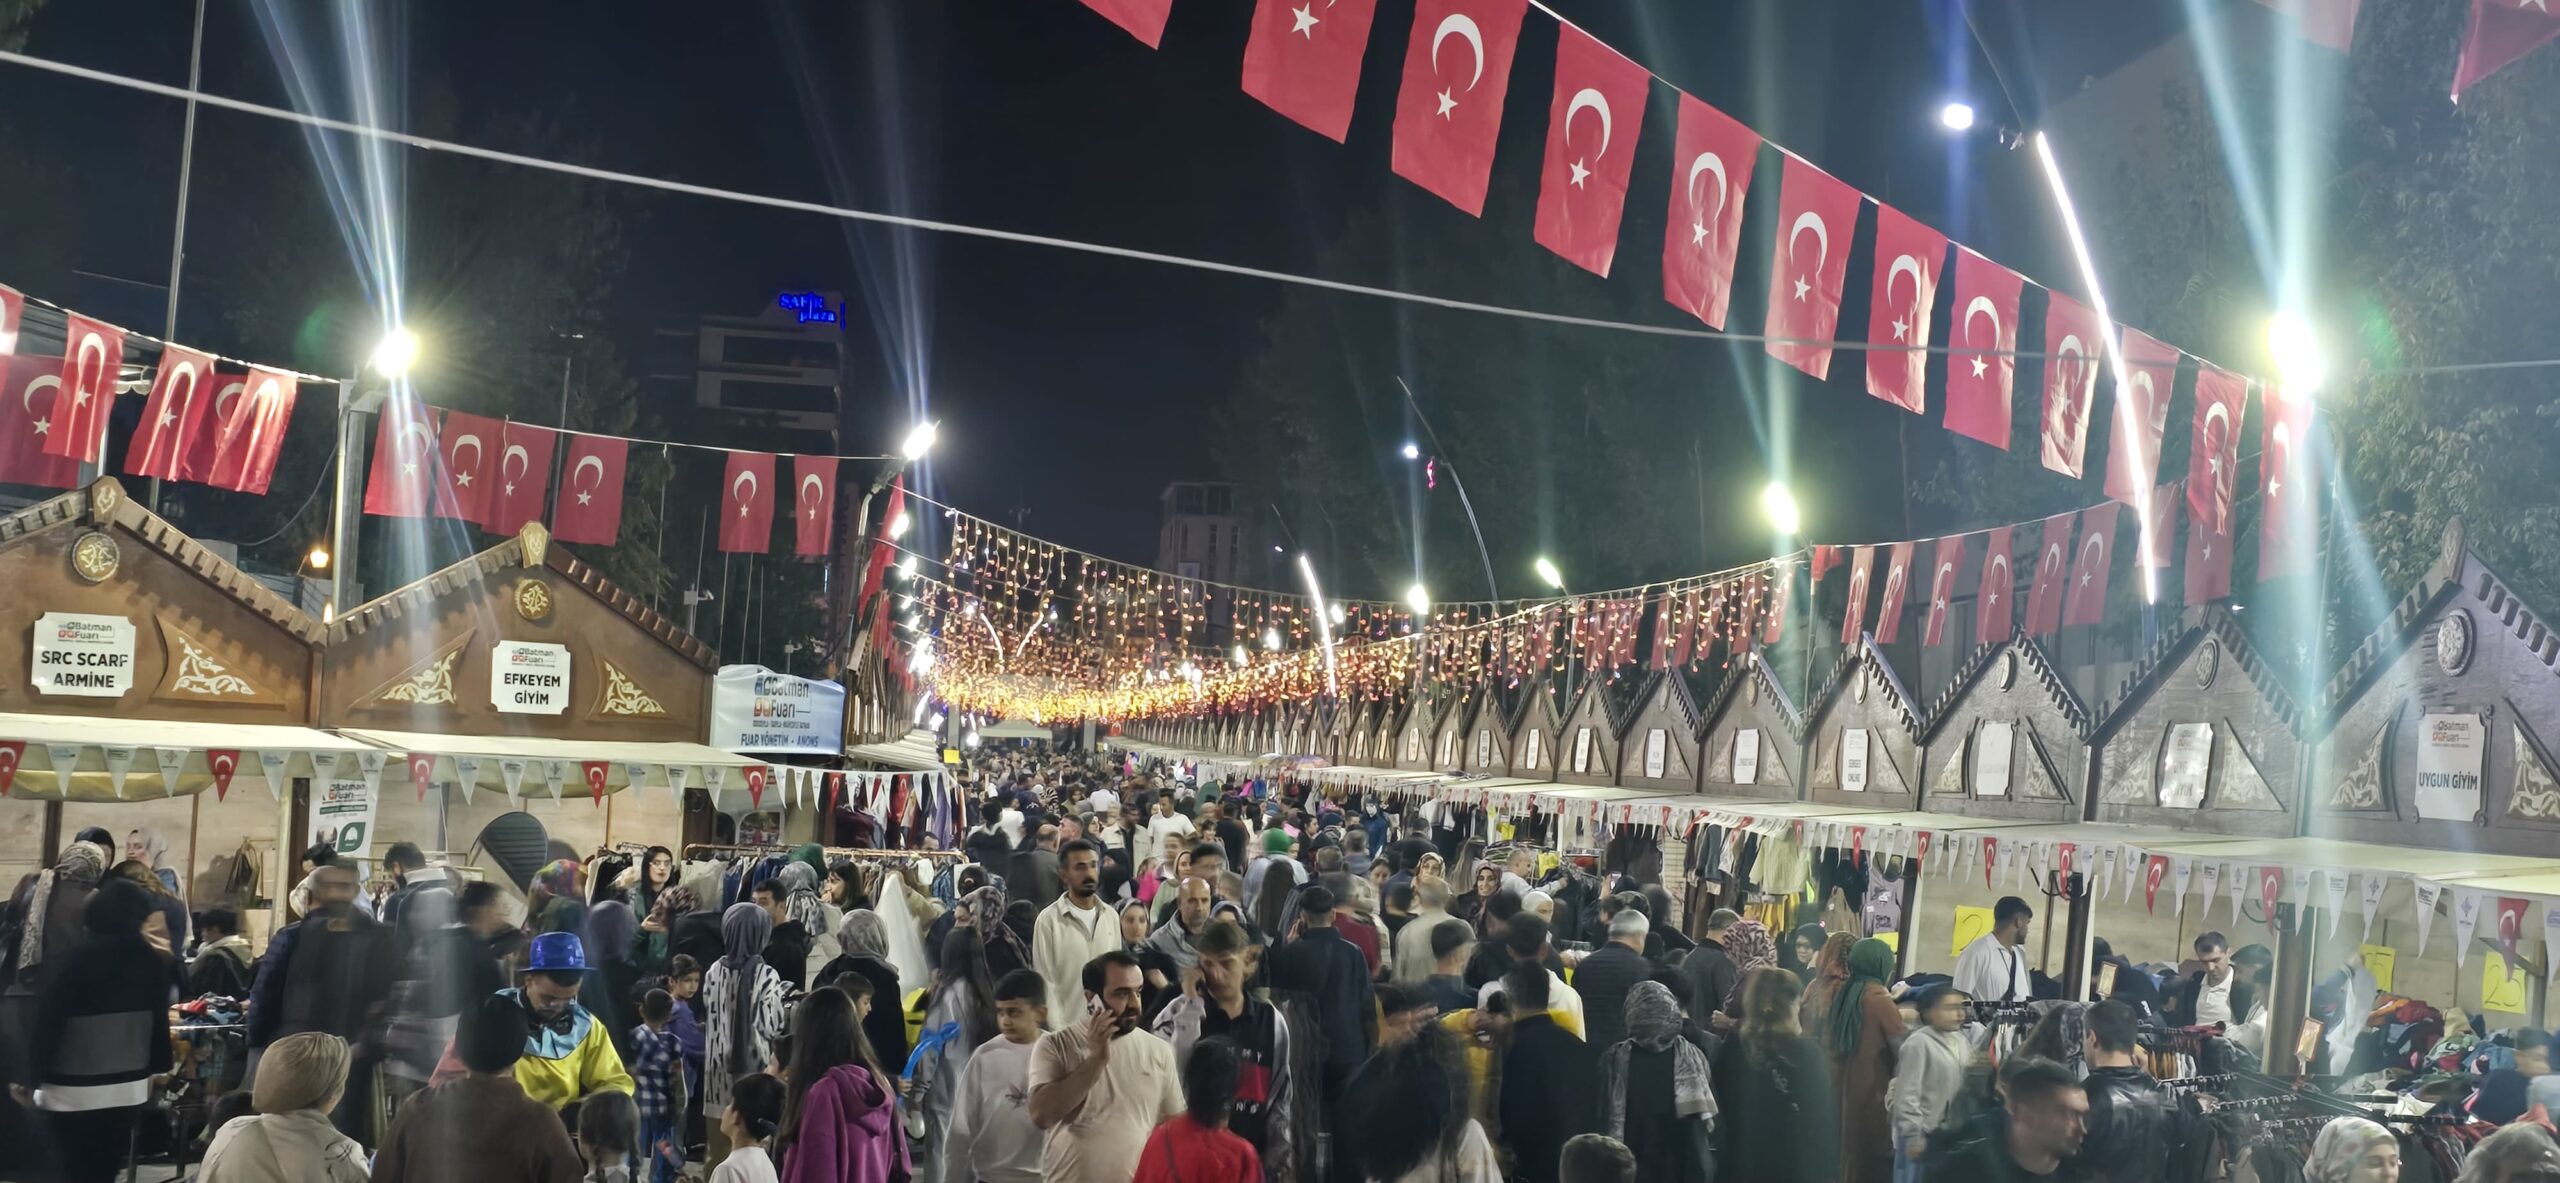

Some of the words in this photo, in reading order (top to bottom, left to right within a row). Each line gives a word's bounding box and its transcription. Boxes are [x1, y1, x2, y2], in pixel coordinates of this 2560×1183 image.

[75, 622, 112, 632] Batman
[41, 651, 72, 665] SRC
[77, 653, 128, 667] SCARF
[525, 648, 554, 656] Batman
[53, 671, 115, 688] ARMİNE
[504, 673, 561, 687] EFKEYEM
[771, 678, 809, 698] Batman
[514, 690, 549, 705] GİYİM
[771, 700, 796, 718] Fuarı
[740, 733, 759, 747] FUAR
[2418, 772, 2450, 788] UYGUN
[2451, 771, 2478, 790] GİYİM
